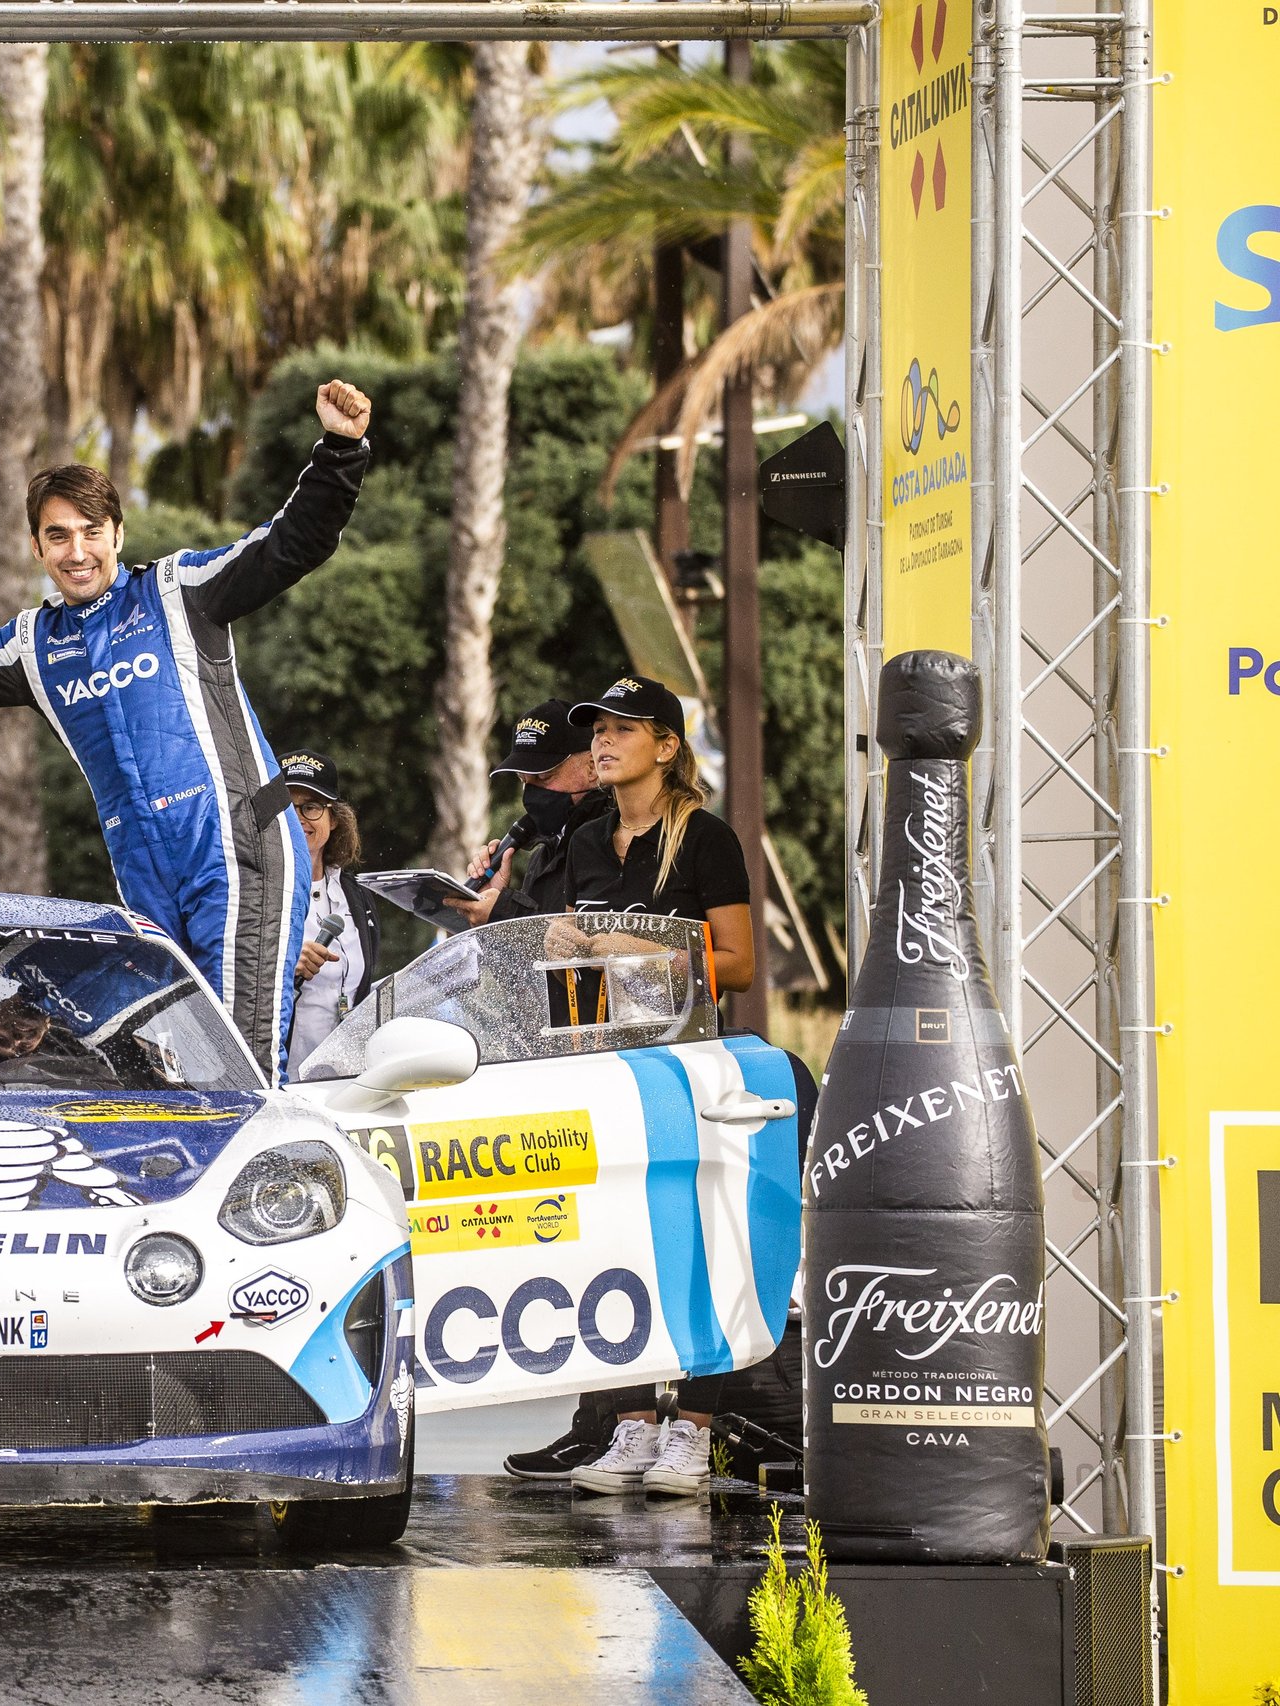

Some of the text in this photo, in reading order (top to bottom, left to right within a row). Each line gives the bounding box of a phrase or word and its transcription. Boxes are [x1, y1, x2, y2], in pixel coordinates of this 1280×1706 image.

[890, 62, 968, 151] CATALUNYA
[781, 471, 827, 481] SENNHEISER
[892, 451, 968, 508] COSTA DAURADA
[77, 591, 113, 619] YACCO
[111, 624, 154, 646] ALPINE
[55, 652, 160, 707] YACCO
[281, 754, 325, 771] RallyRACC
[167, 783, 208, 804] P. RAGUES
[896, 770, 969, 982] Freixenet
[920, 1022, 946, 1030] BRUT
[520, 1128, 589, 1151] Mobility
[809, 1063, 1022, 1199] FREIXENET
[418, 1133, 516, 1183] RACC
[524, 1152, 561, 1173] Club
[461, 1214, 514, 1228] CATALUNYA
[526, 1213, 568, 1224] PortAventura
[537, 1222, 560, 1230] WORLD
[243, 1288, 301, 1307] YACCO
[814, 1264, 1044, 1369] Freixenet
[414, 1267, 652, 1388] CCO
[32, 1330, 47, 1347] 14
[872, 1369, 999, 1380] MÉTODO TRADICIONAL
[834, 1383, 1033, 1403] CORDON NEGRO
[859, 1408, 1013, 1421] GRAN SELECCIÓN
[906, 1432, 970, 1446] CAVA
